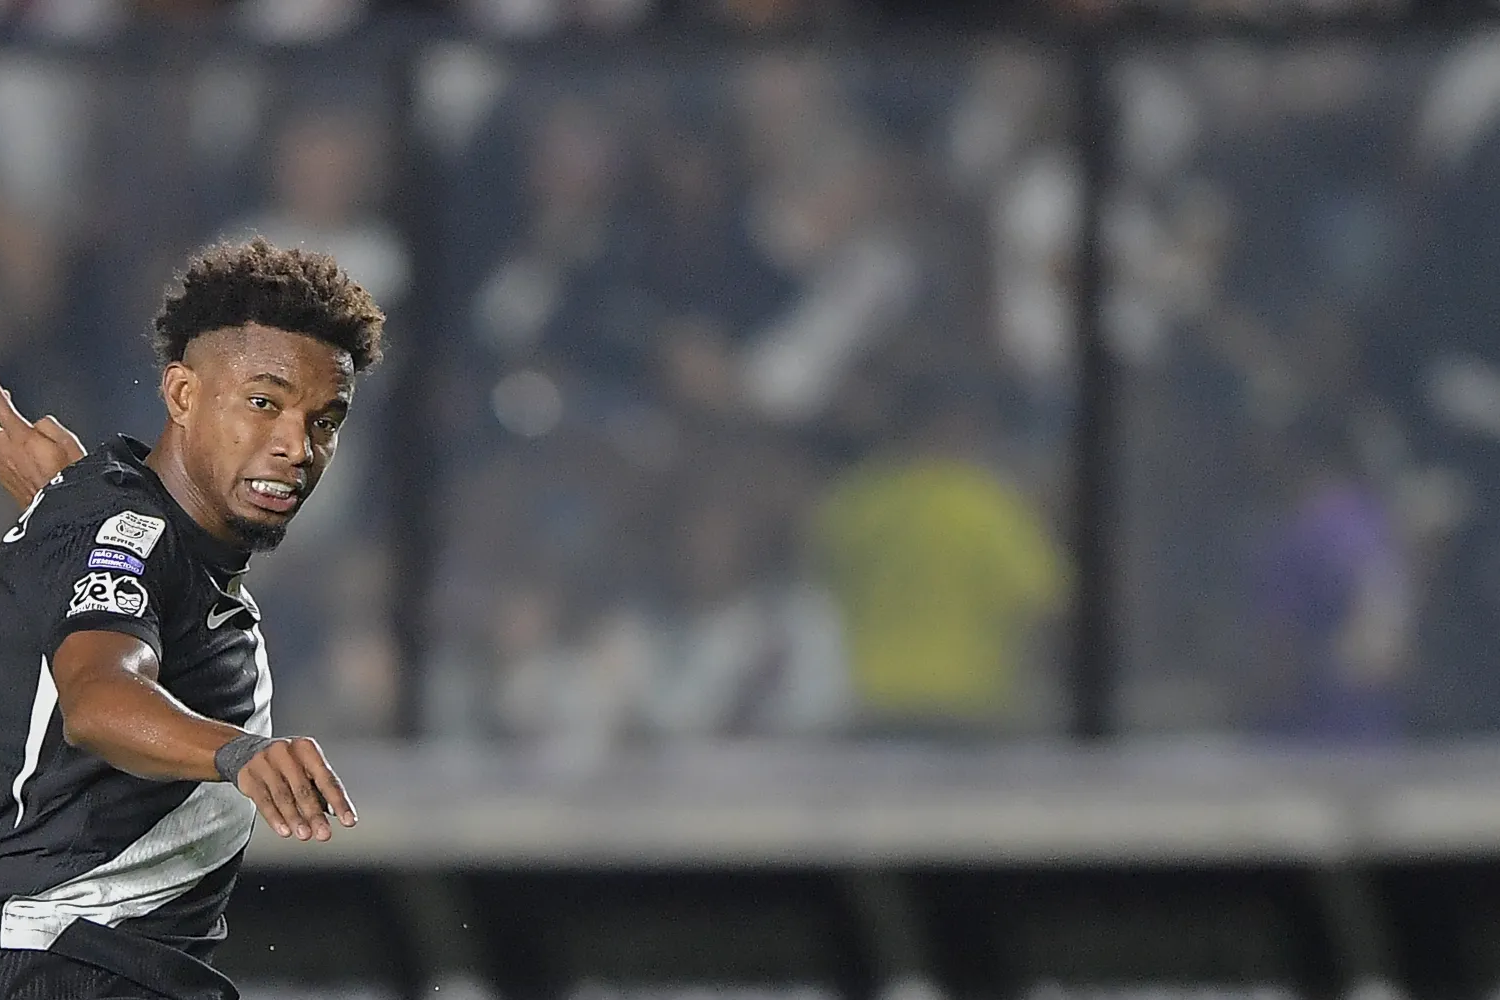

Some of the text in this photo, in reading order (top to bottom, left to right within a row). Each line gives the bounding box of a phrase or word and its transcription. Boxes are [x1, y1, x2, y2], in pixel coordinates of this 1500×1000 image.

[135, 546, 143, 554] A
[94, 550, 125, 561] NÃO AO
